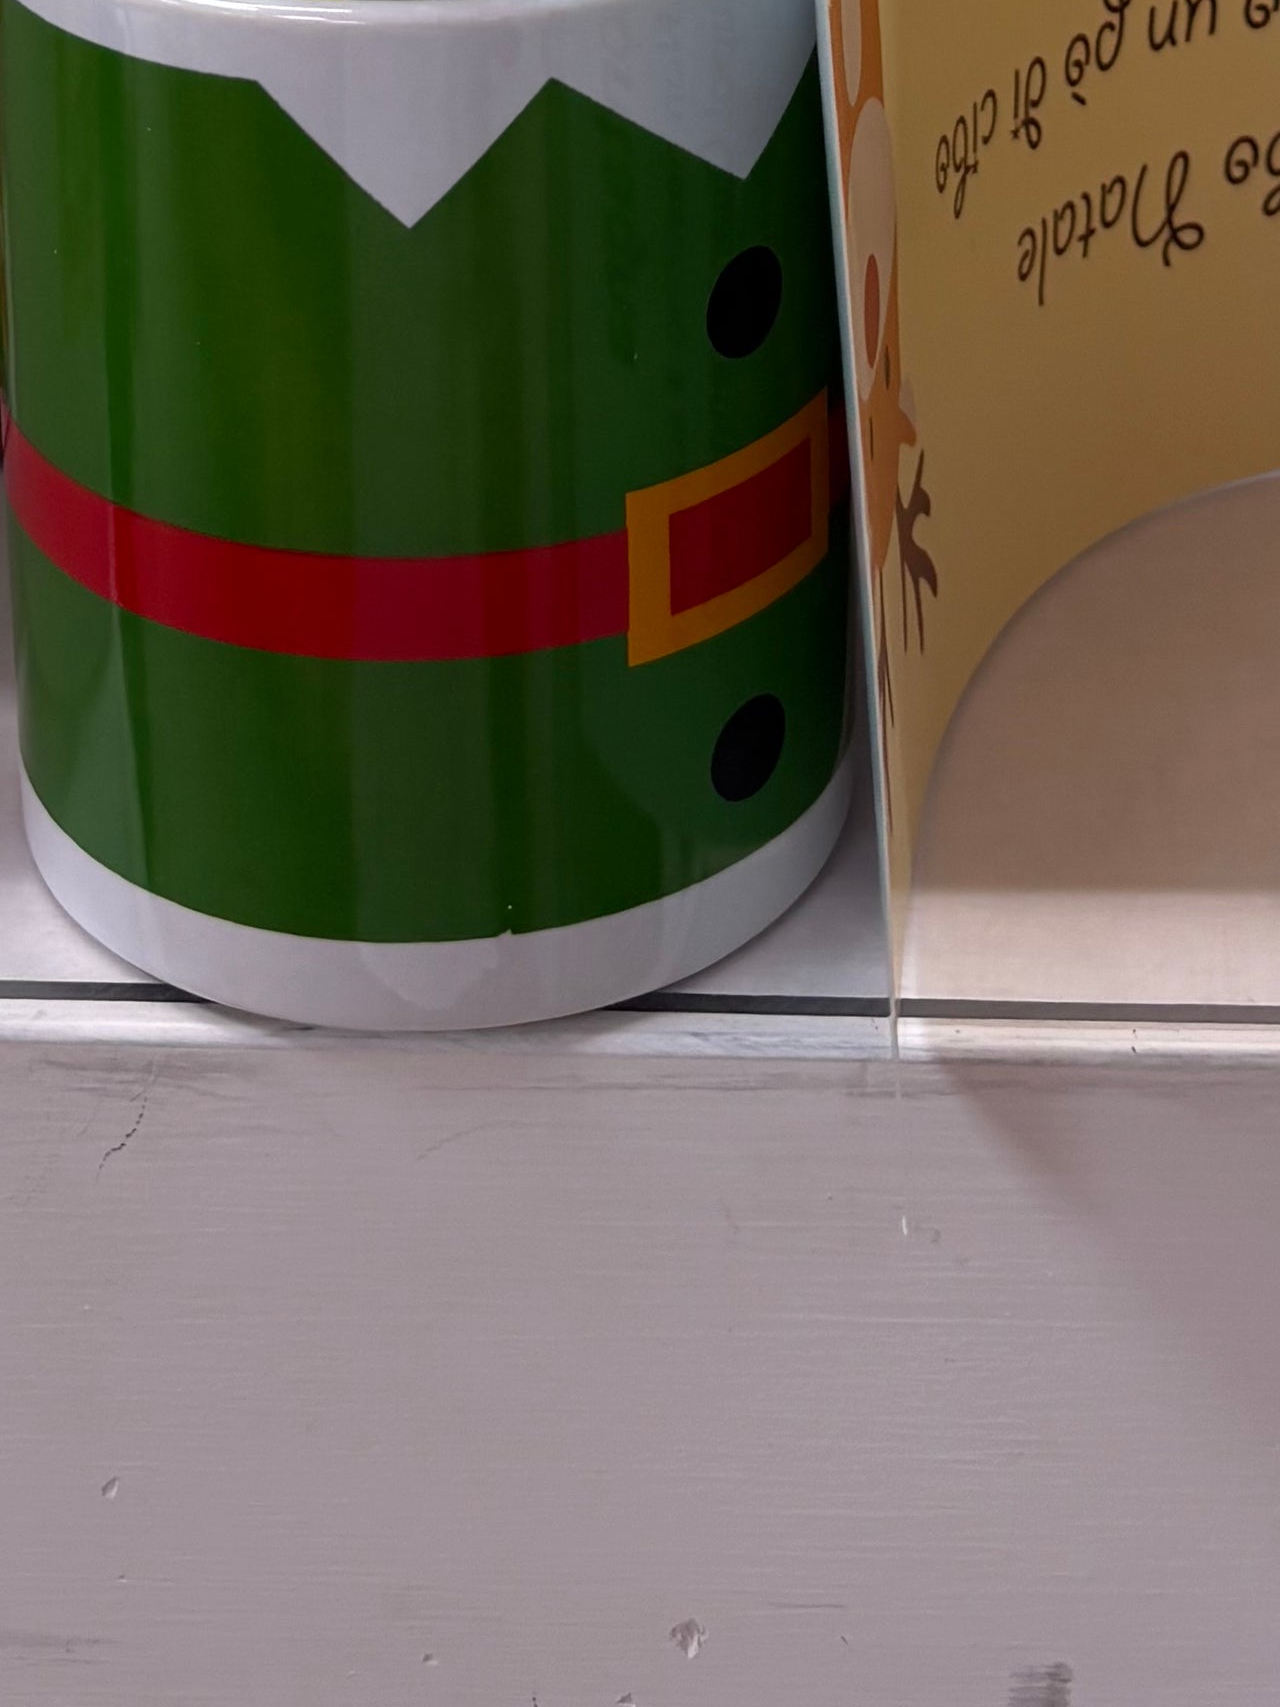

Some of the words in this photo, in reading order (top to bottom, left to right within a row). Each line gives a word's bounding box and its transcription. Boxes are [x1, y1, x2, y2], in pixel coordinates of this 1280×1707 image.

[935, 89, 999, 220] cibo
[1011, 54, 1047, 151] di
[1017, 149, 1207, 306] Natale
